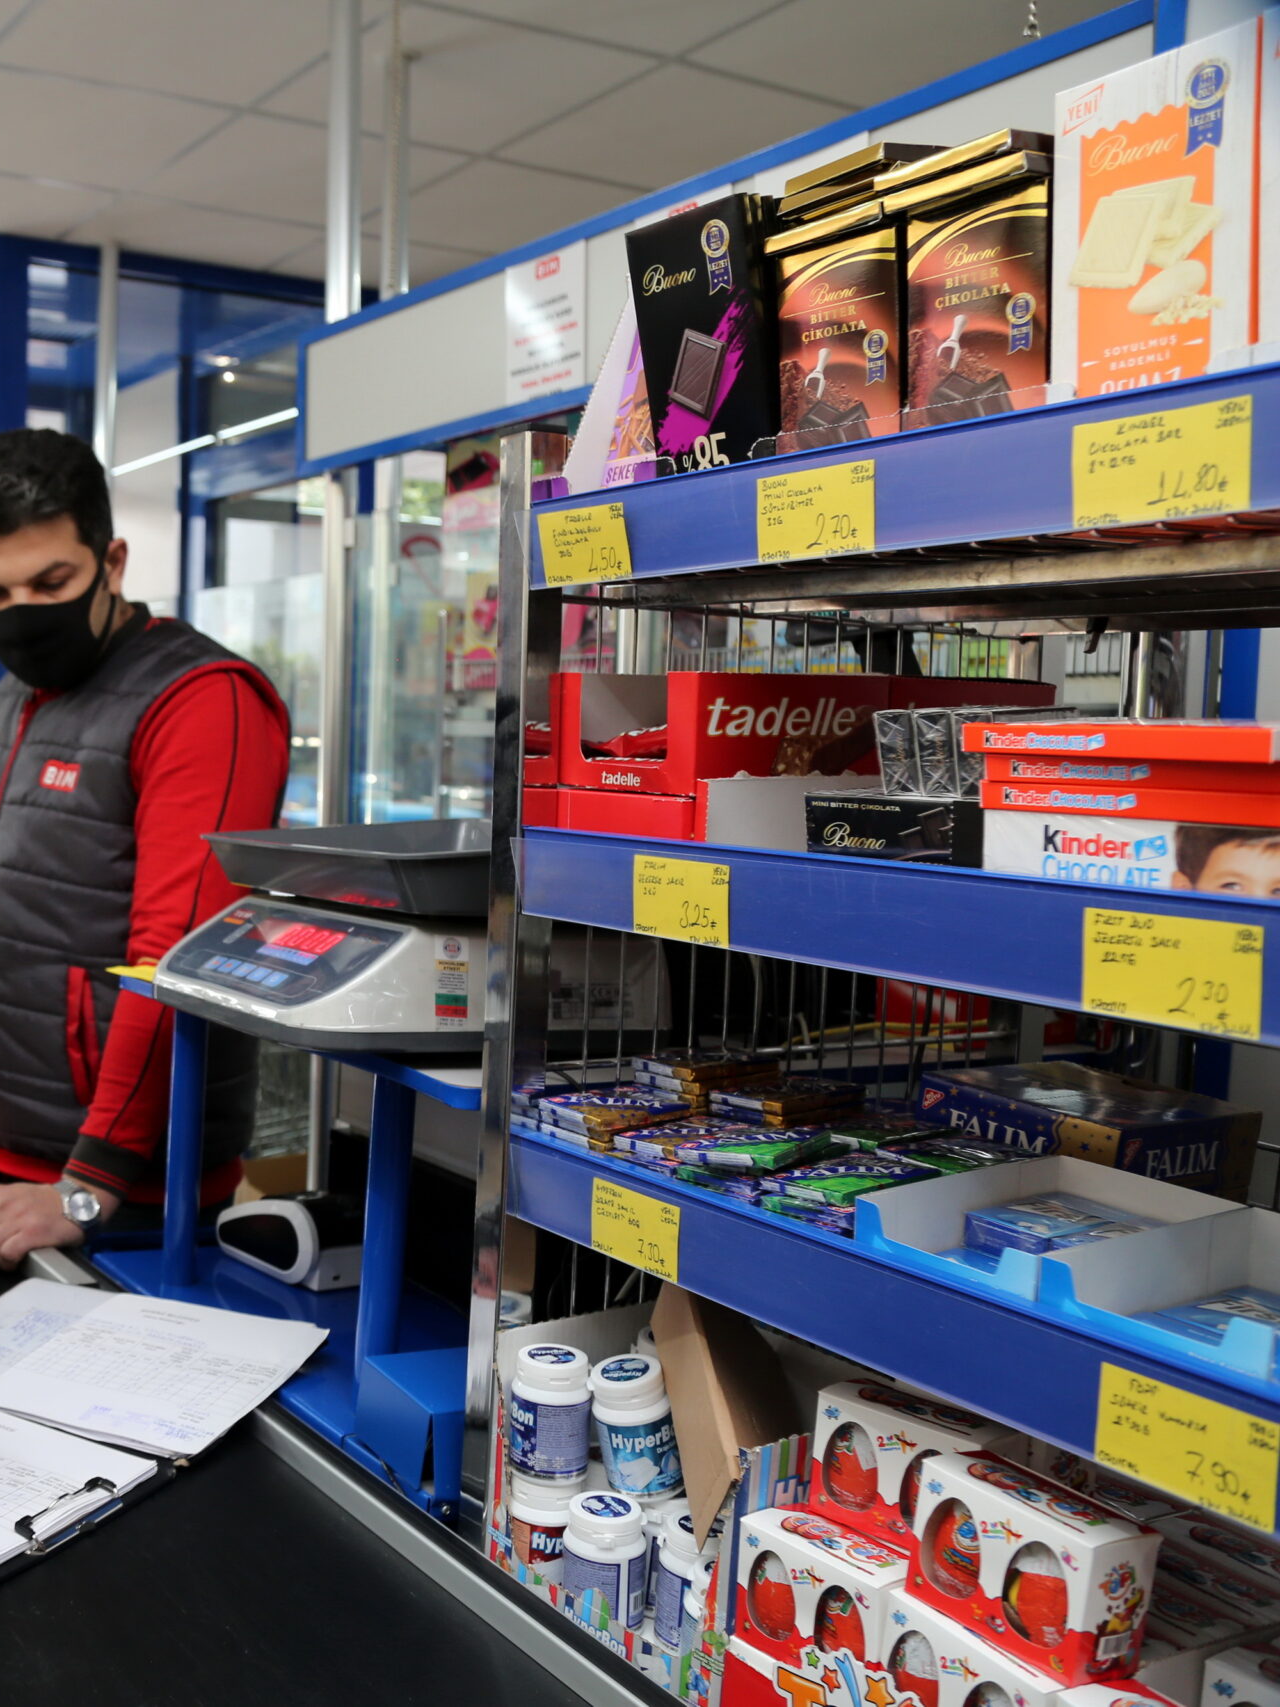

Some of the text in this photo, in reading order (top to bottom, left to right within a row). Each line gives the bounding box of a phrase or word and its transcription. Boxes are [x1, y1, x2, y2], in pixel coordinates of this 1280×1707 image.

[945, 243, 1001, 270] Buono
[642, 264, 697, 297] Buono
[935, 282, 1012, 312] ÇİKOLATA
[801, 319, 868, 345] ÇİKOLATA
[1109, 350, 1171, 371] BADEMLİ
[706, 697, 857, 737] tadelle
[984, 731, 1088, 750] Kinder CHOCOLATE
[601, 770, 641, 787] tadelle
[1011, 760, 1130, 781] Kinder CHOCOLATE
[1003, 787, 1118, 810] Kinder CHOCOLATE
[822, 821, 887, 850] Buono
[1043, 824, 1130, 859] Kinder
[948, 1108, 1048, 1155] FALIM
[792, 1165, 906, 1178] FALIM
[1145, 1141, 1220, 1180] FALIM
